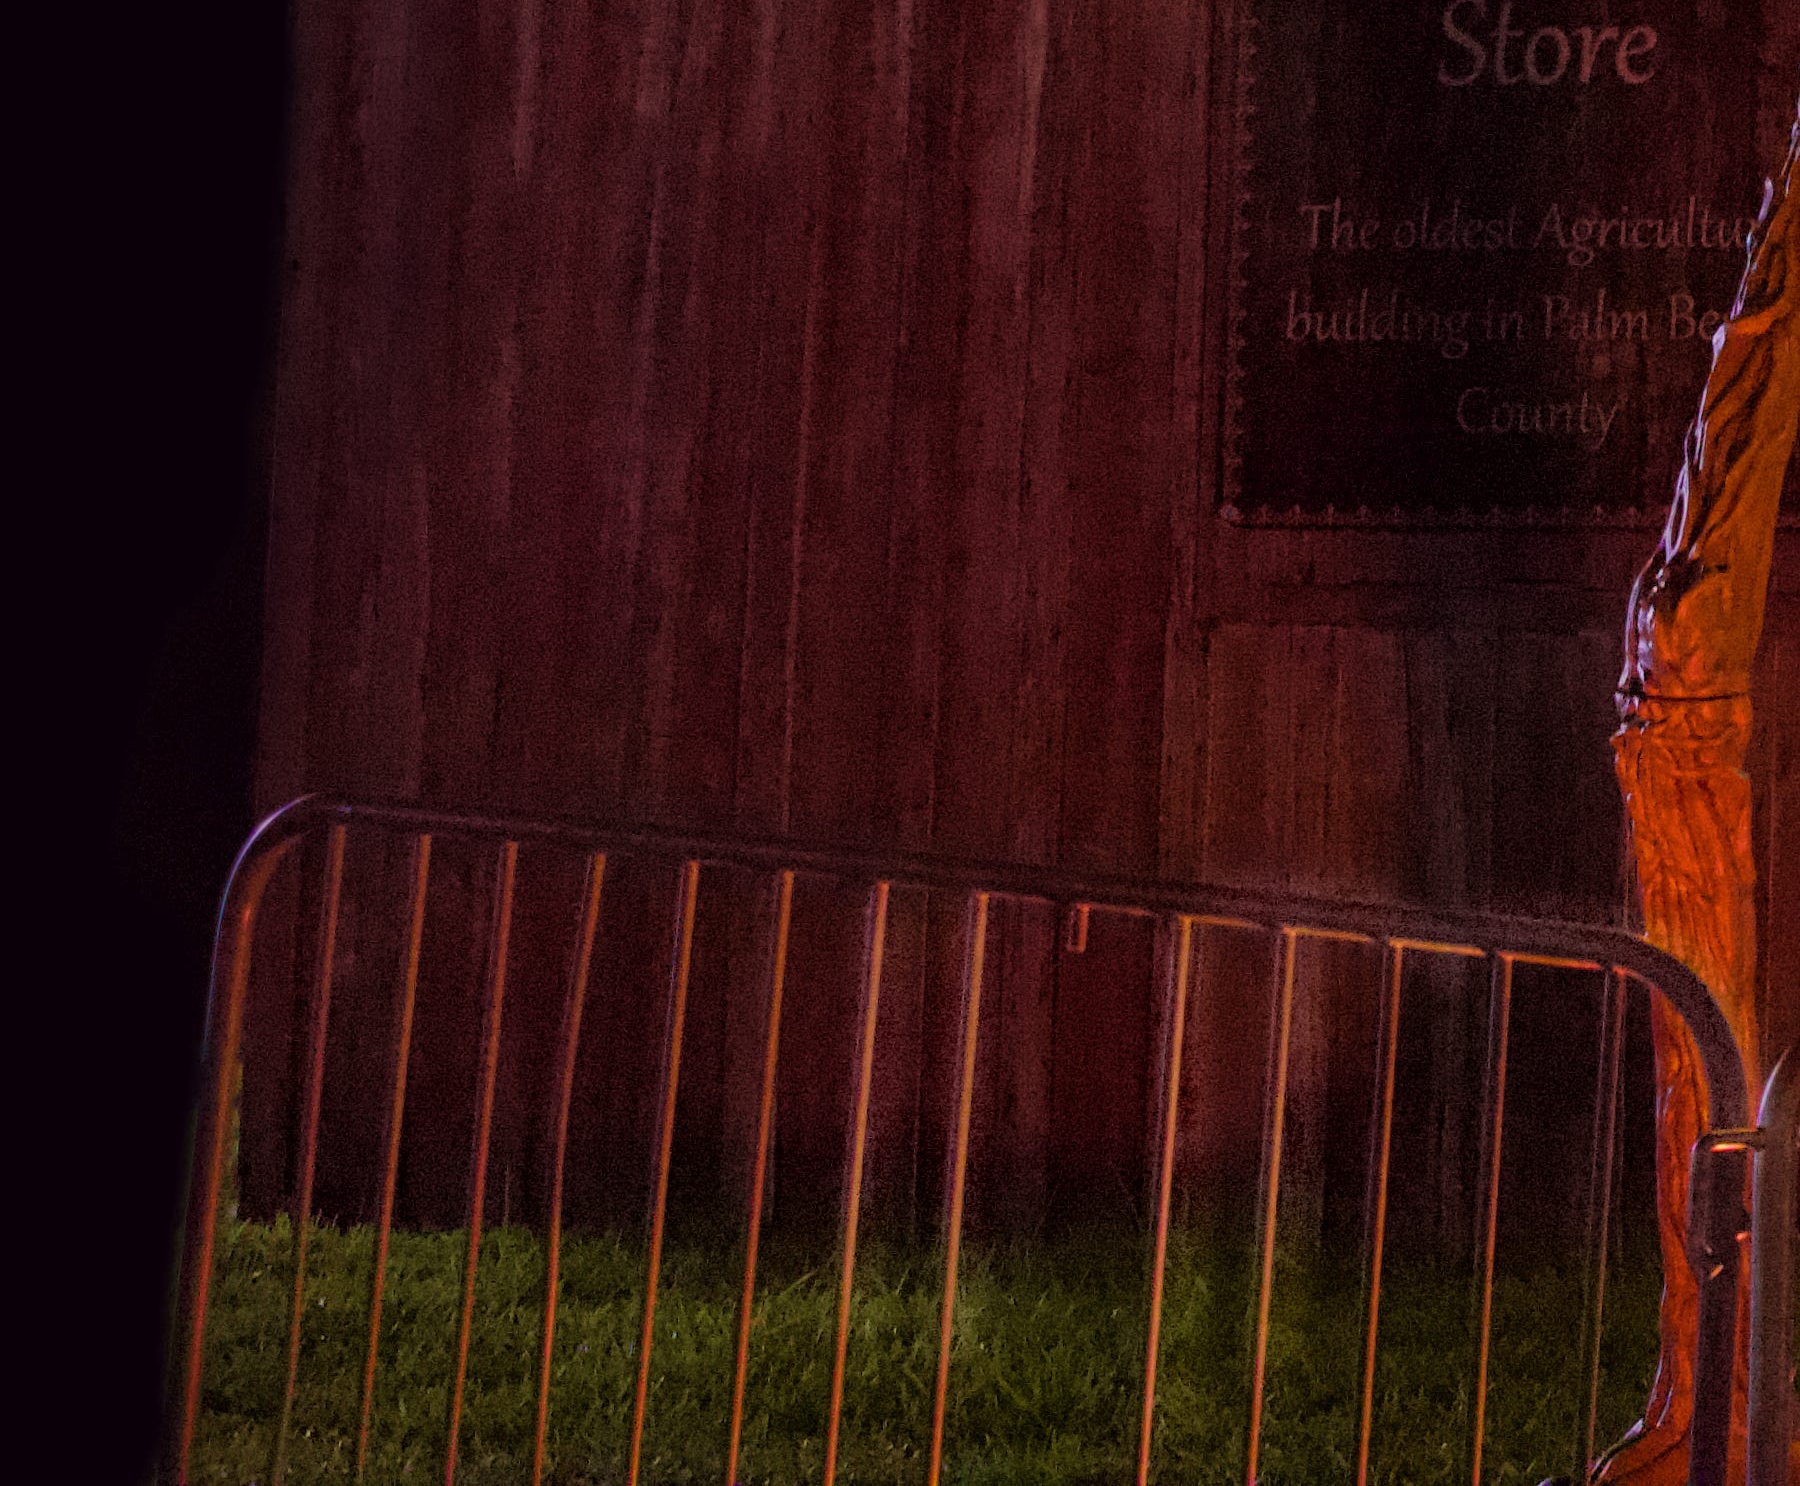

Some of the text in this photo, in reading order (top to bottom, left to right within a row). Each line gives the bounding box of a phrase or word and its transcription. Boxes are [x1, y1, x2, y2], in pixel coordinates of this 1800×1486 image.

[1299, 197, 1382, 251] The
[1393, 198, 1524, 251] oldest
[1285, 288, 1728, 360] building in Palm Be
[1456, 386, 1629, 451] County
